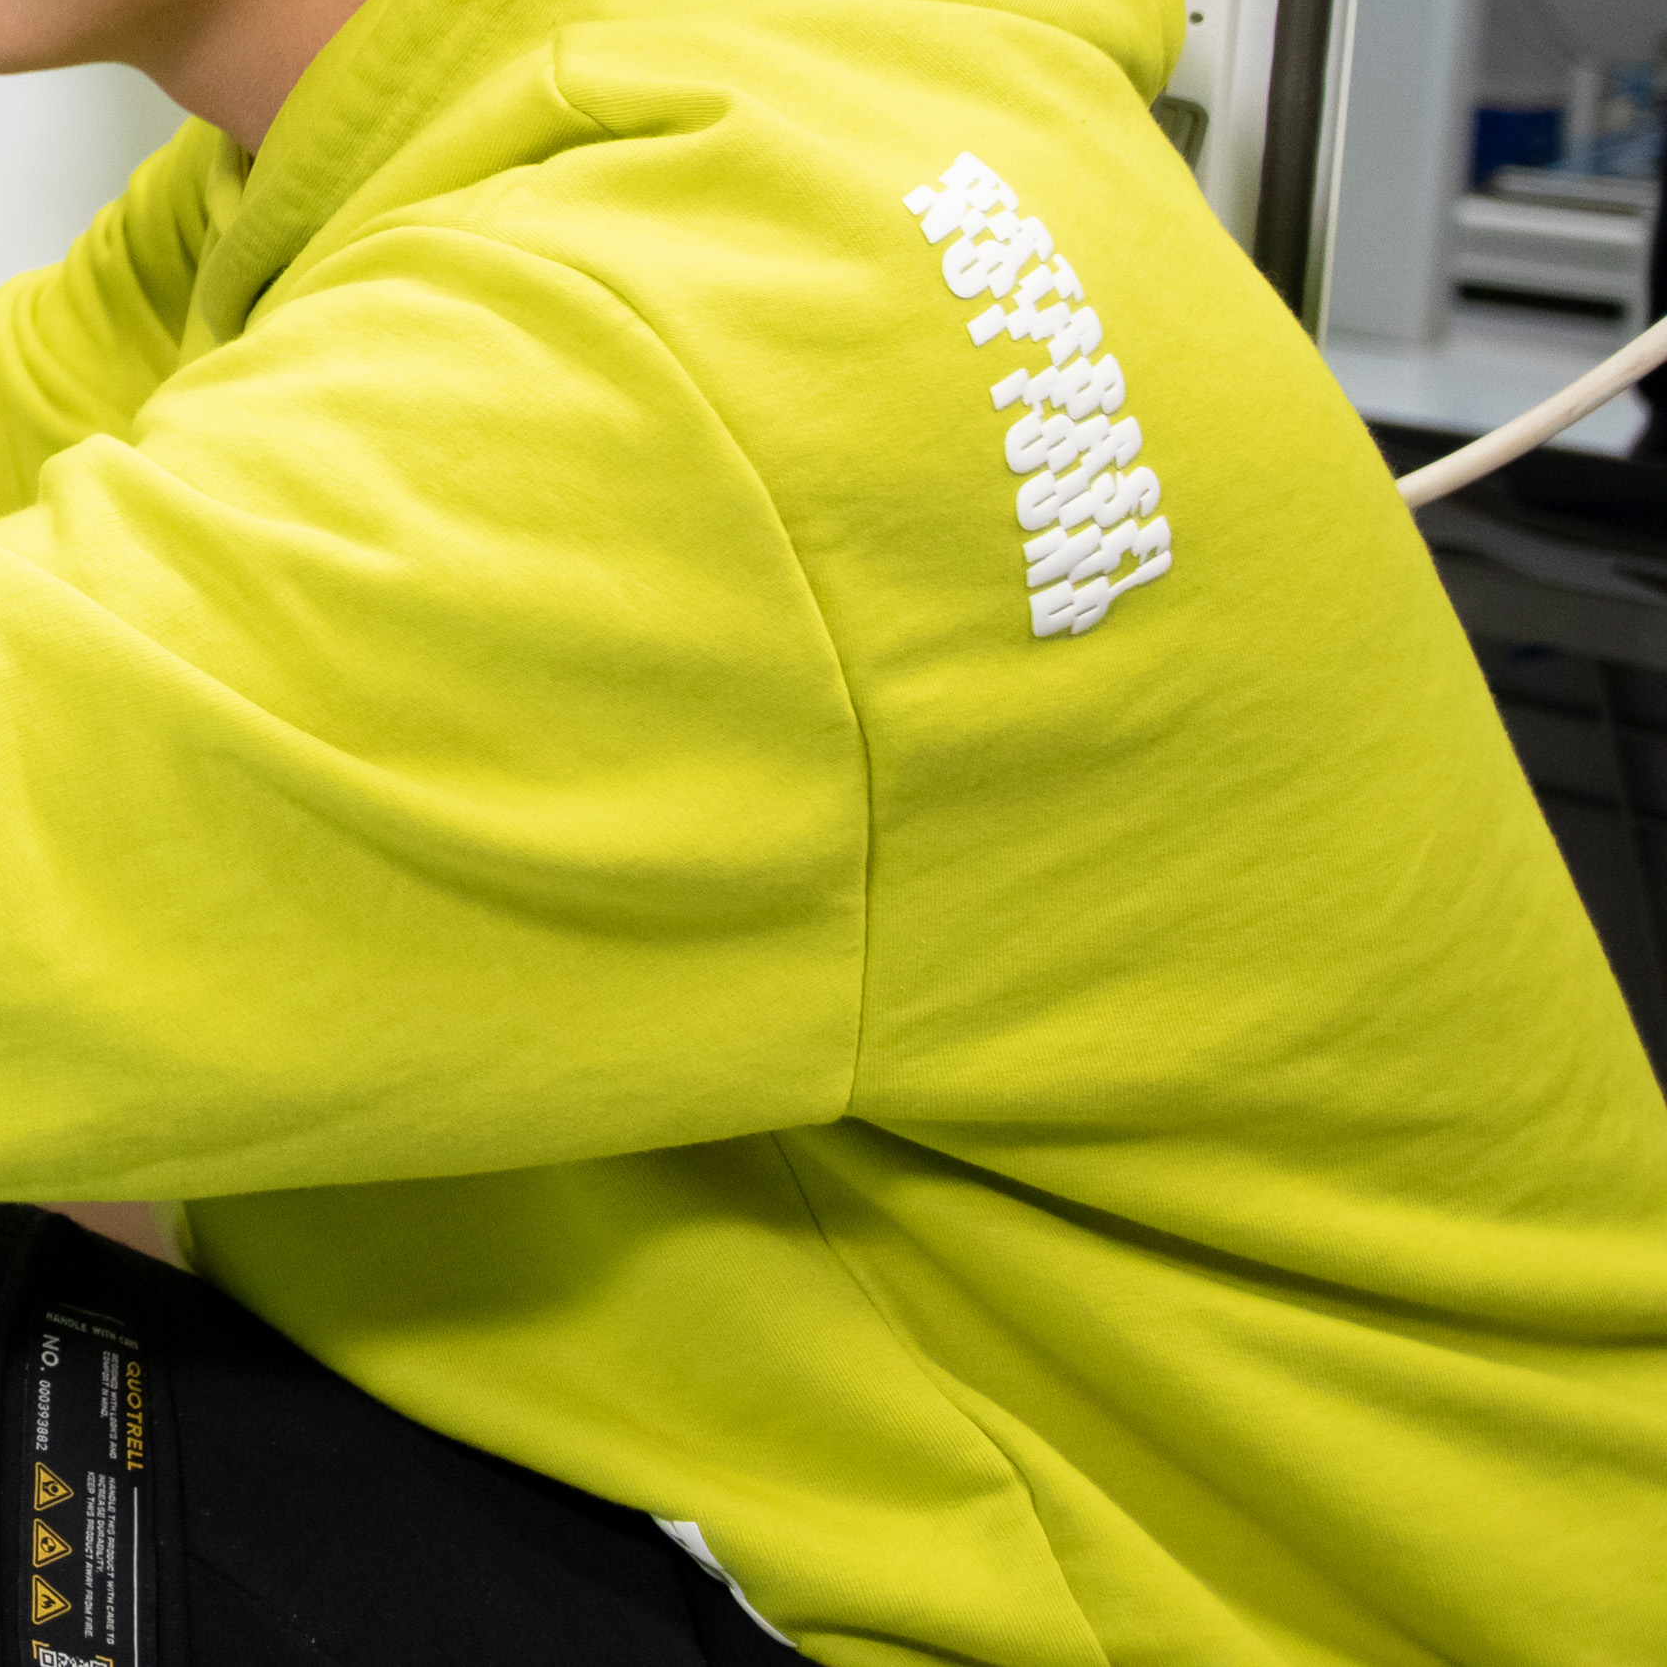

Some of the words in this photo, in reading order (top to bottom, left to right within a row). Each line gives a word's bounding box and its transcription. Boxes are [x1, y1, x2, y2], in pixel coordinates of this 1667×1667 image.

[40, 1334, 60, 1372] NO.
[102, 1388, 109, 1396] IN
[126, 1361, 143, 1471] QUOTRELL
[109, 1441, 117, 1459] AND
[87, 1471, 95, 1495] KEEP
[108, 1477, 116, 1512] HANDLE
[86, 1497, 94, 1517] THIS
[97, 1474, 105, 1518] INCREASE
[107, 1515, 115, 1535] THIS
[85, 1519, 94, 1560] PRODUCT
[106, 1536, 115, 1578] PRODUCT
[85, 1561, 93, 1588] AWAY
[85, 1589, 93, 1614] FROM
[106, 1580, 114, 1604] WITH
[106, 1605, 114, 1630] CARE
[106, 1633, 114, 1645] TO
